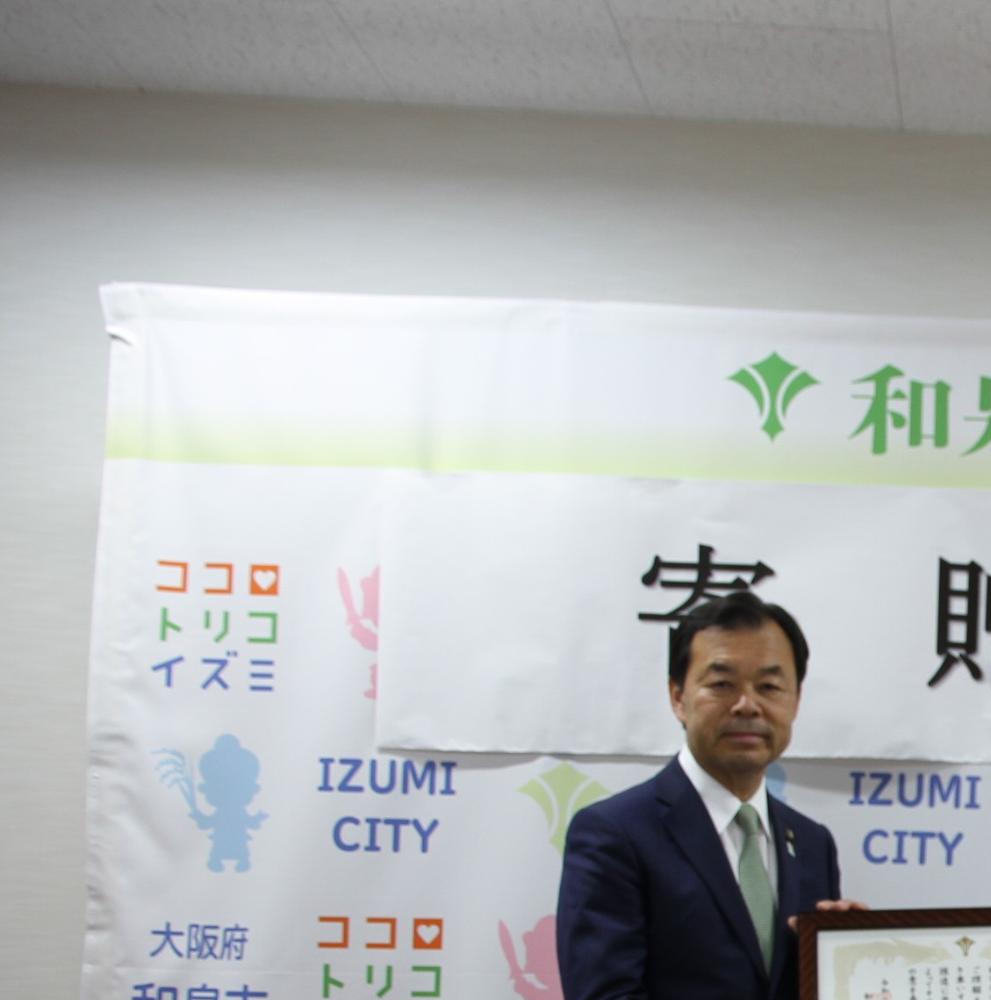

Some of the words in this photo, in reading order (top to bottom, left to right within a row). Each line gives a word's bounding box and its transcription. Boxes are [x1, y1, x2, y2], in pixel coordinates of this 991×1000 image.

[160, 608, 278, 644] トリコ
[152, 651, 274, 691] イズミ
[317, 757, 457, 796] IZUMI
[849, 772, 981, 809] IZUMI
[333, 816, 439, 853] CITY
[862, 829, 963, 866] CITY
[150, 922, 248, 960] 大阪府
[323, 964, 441, 998] トリコ
